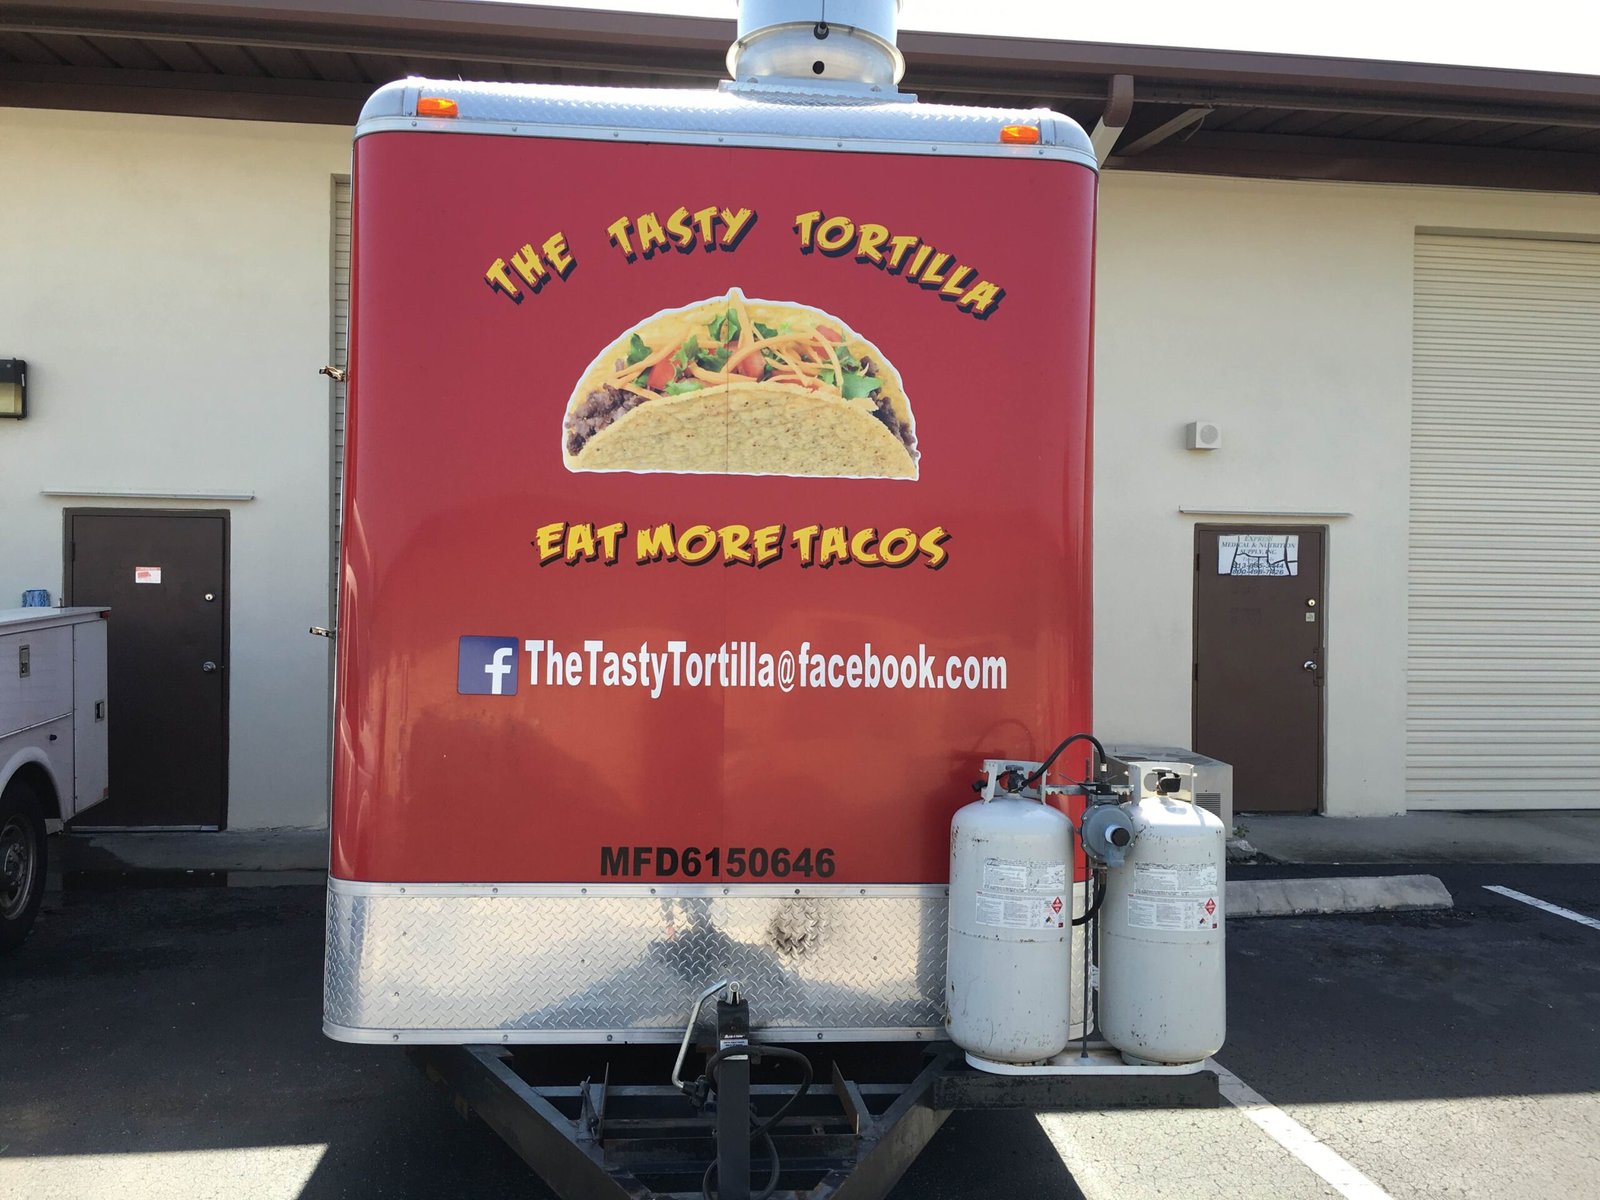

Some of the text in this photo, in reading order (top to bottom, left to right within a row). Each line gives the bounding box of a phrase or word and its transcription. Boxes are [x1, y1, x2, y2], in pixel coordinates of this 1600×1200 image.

[485, 206, 1007, 321] THE TASTY TORTILLA
[532, 522, 952, 570] EAT MORE TACOS
[524, 640, 1008, 699] TheTastyTortilla@facebook.com
[600, 846, 836, 878] MFD6150646
